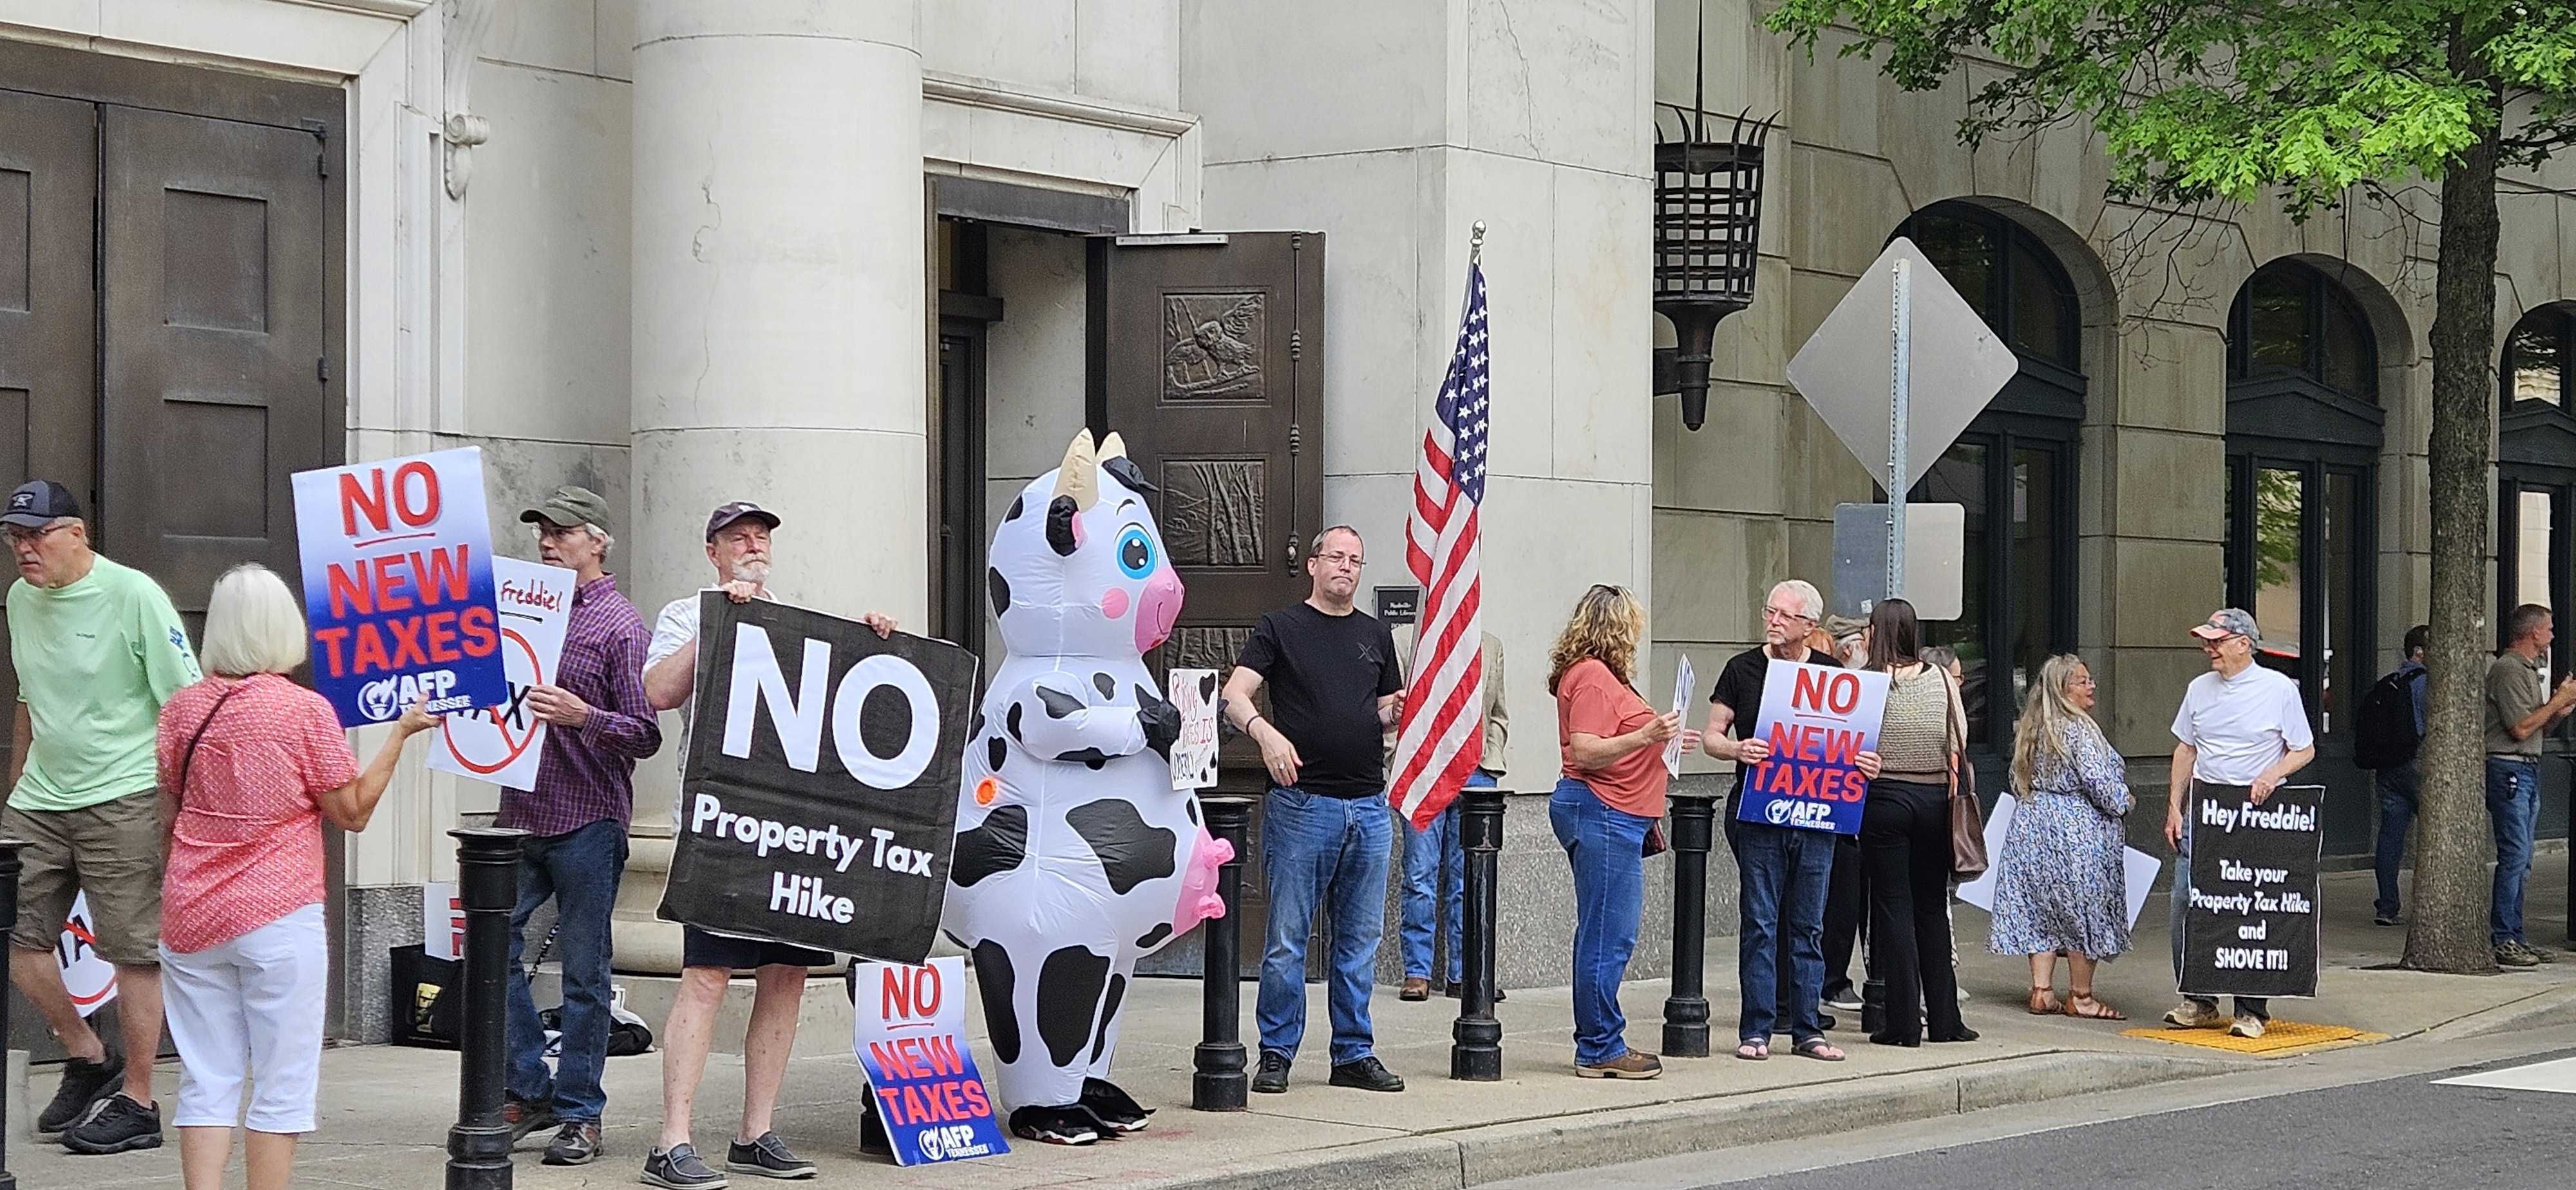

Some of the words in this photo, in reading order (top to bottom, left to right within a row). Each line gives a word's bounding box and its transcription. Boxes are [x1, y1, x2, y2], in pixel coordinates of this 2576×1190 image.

[339, 461, 440, 536] NO
[327, 544, 469, 619] NEW
[500, 578, 562, 612] Freddie!
[315, 606, 497, 678] TAXES
[399, 669, 456, 704] AFP
[722, 621, 940, 790] NO
[1792, 668, 1860, 714] NO
[1200, 716, 1213, 744] IS
[1769, 721, 1865, 765] NEW
[1754, 761, 1866, 802] TAXES
[1792, 801, 1831, 820] AFP
[2202, 798, 2239, 833] Hey
[2241, 801, 2315, 831] Freddie!
[691, 792, 864, 873] Property
[871, 827, 934, 878] Tax
[2219, 859, 2252, 882] Take
[2254, 867, 2289, 887] your
[770, 871, 855, 924] Hike
[2190, 888, 2252, 916] Property
[2254, 891, 2278, 912] Tax
[2280, 891, 2311, 913] Hike
[2238, 920, 2266, 940] and
[2215, 947, 2264, 969] SHOVE
[2266, 949, 2288, 970] IT!!
[882, 963, 941, 1019] NO
[869, 1035, 963, 1081] NEW
[878, 1080, 991, 1126] TAXES
[940, 1125, 974, 1149] AFP
